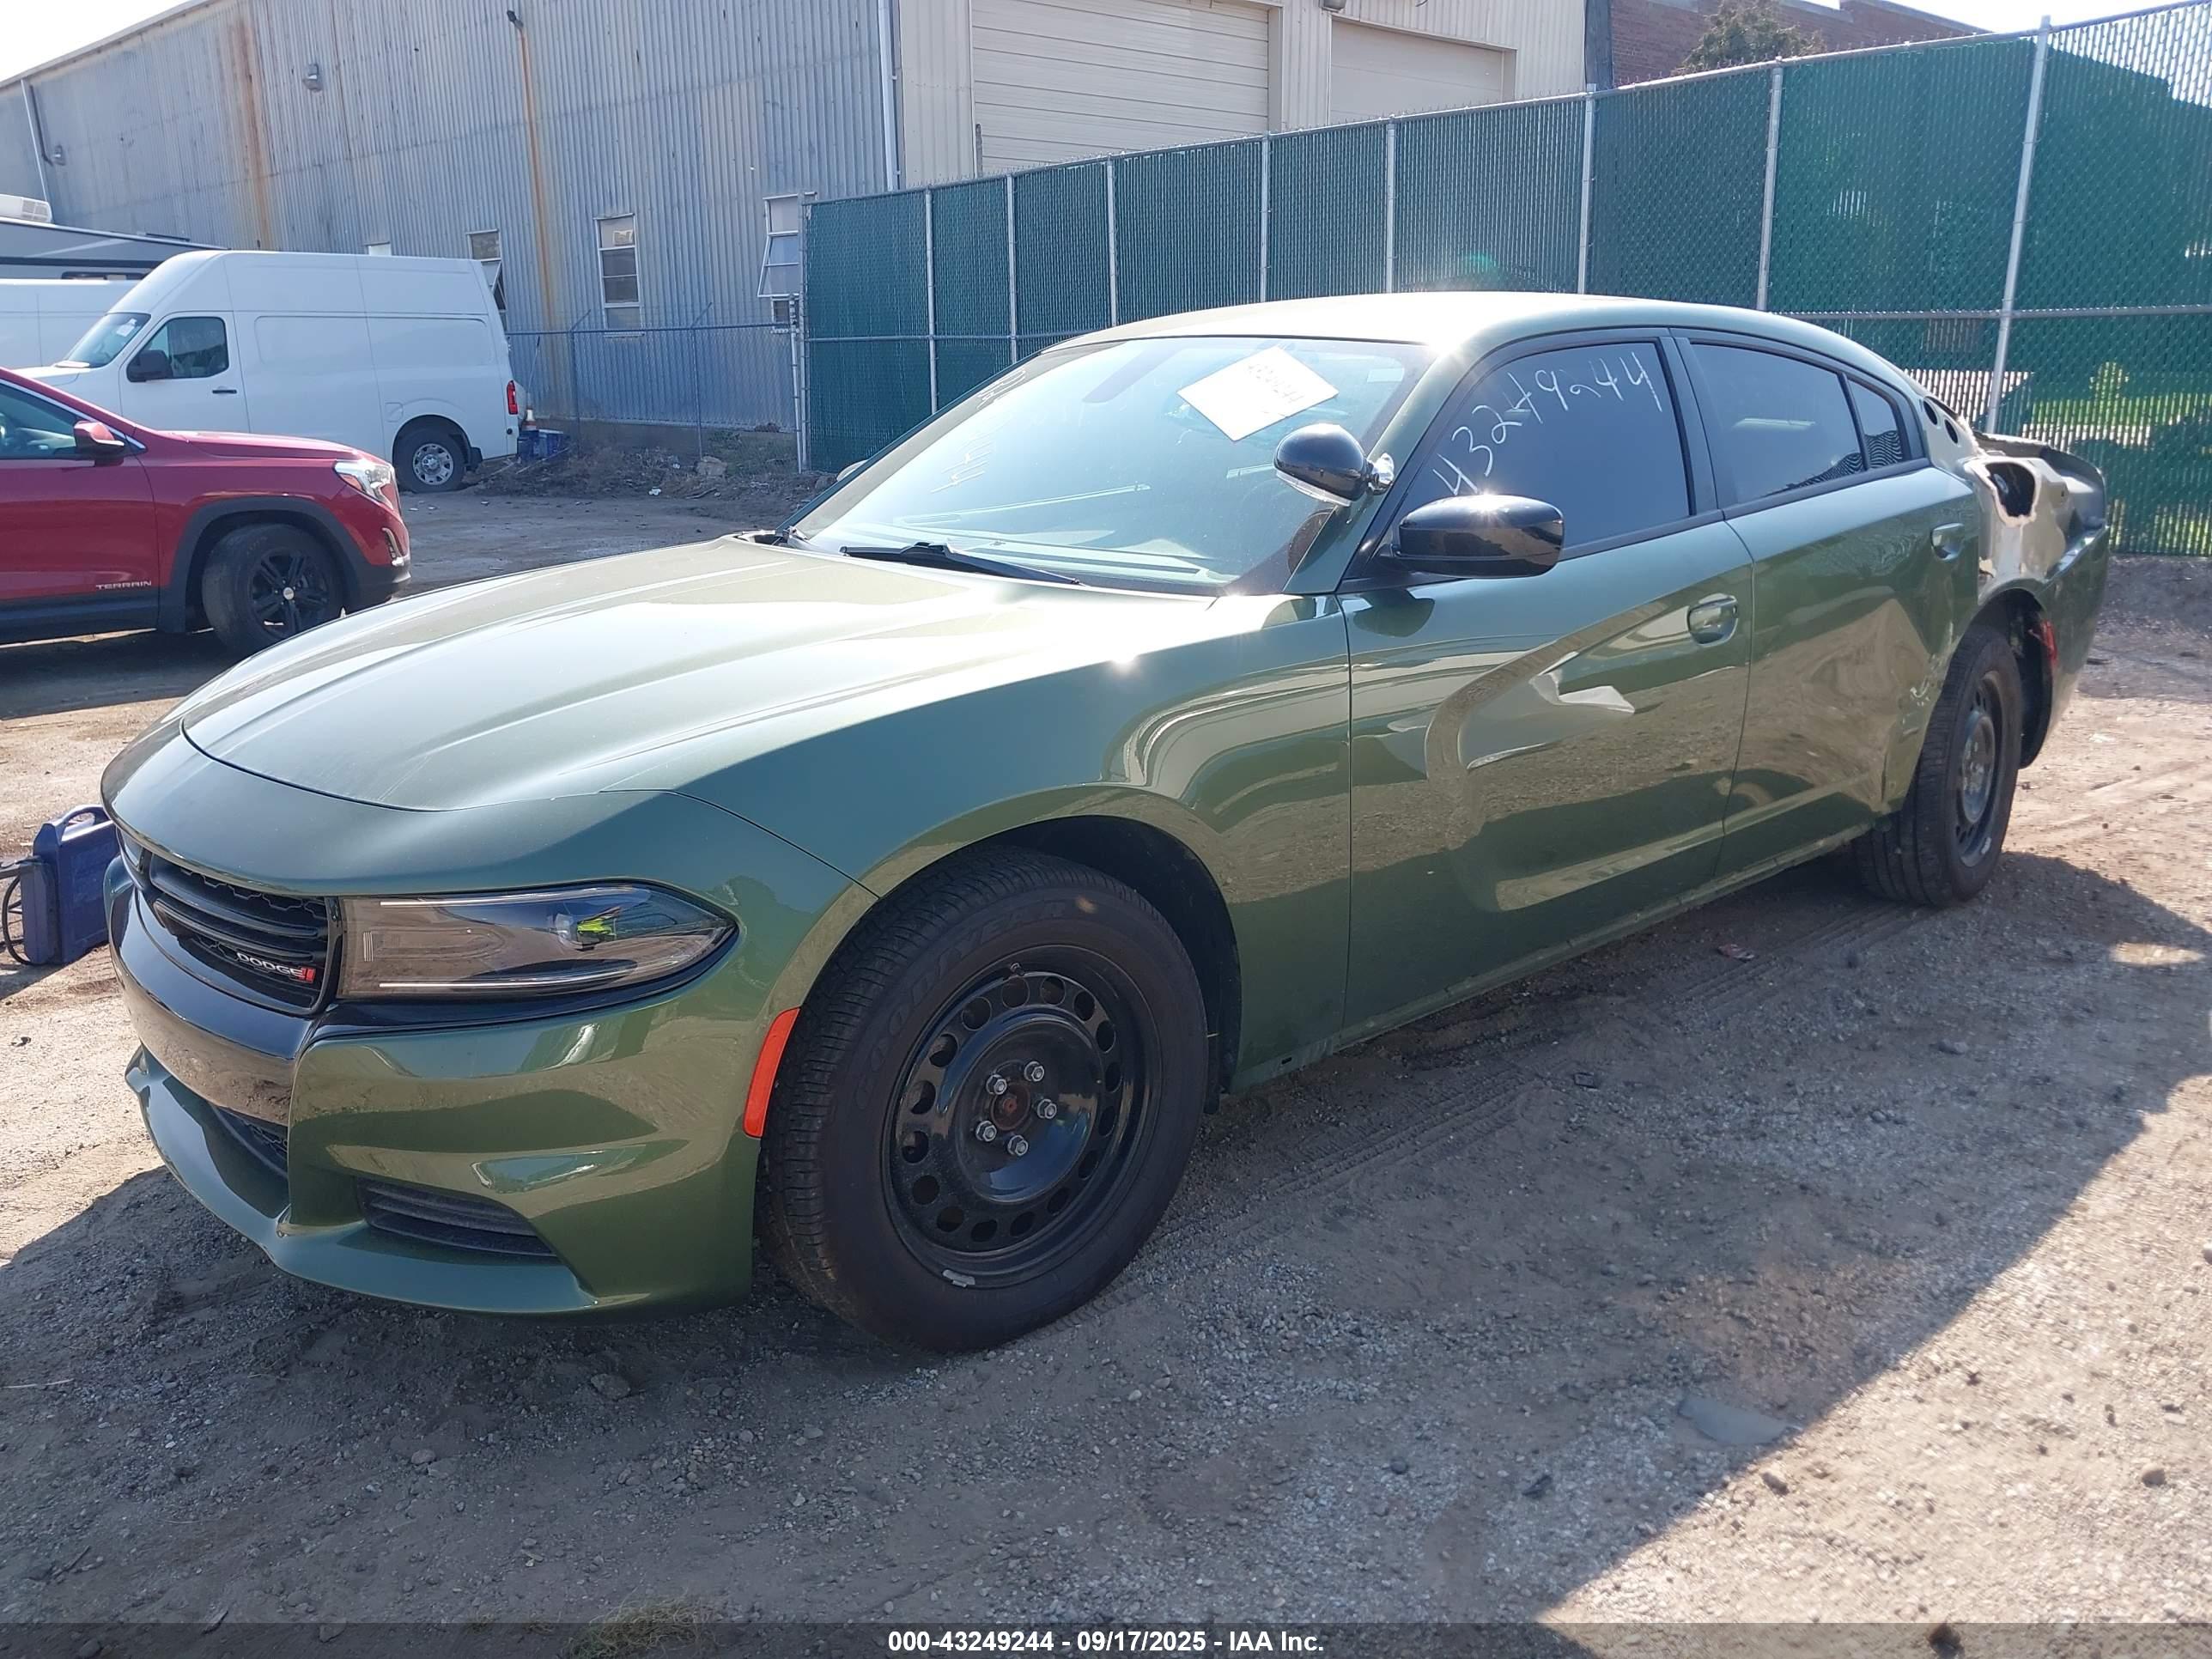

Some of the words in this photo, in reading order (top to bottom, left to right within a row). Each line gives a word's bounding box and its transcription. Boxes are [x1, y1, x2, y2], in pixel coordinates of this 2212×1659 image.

[1431, 351, 1663, 496] 43249244
[95, 580, 152, 590] TERRAIN
[236, 951, 306, 979] DODGE
